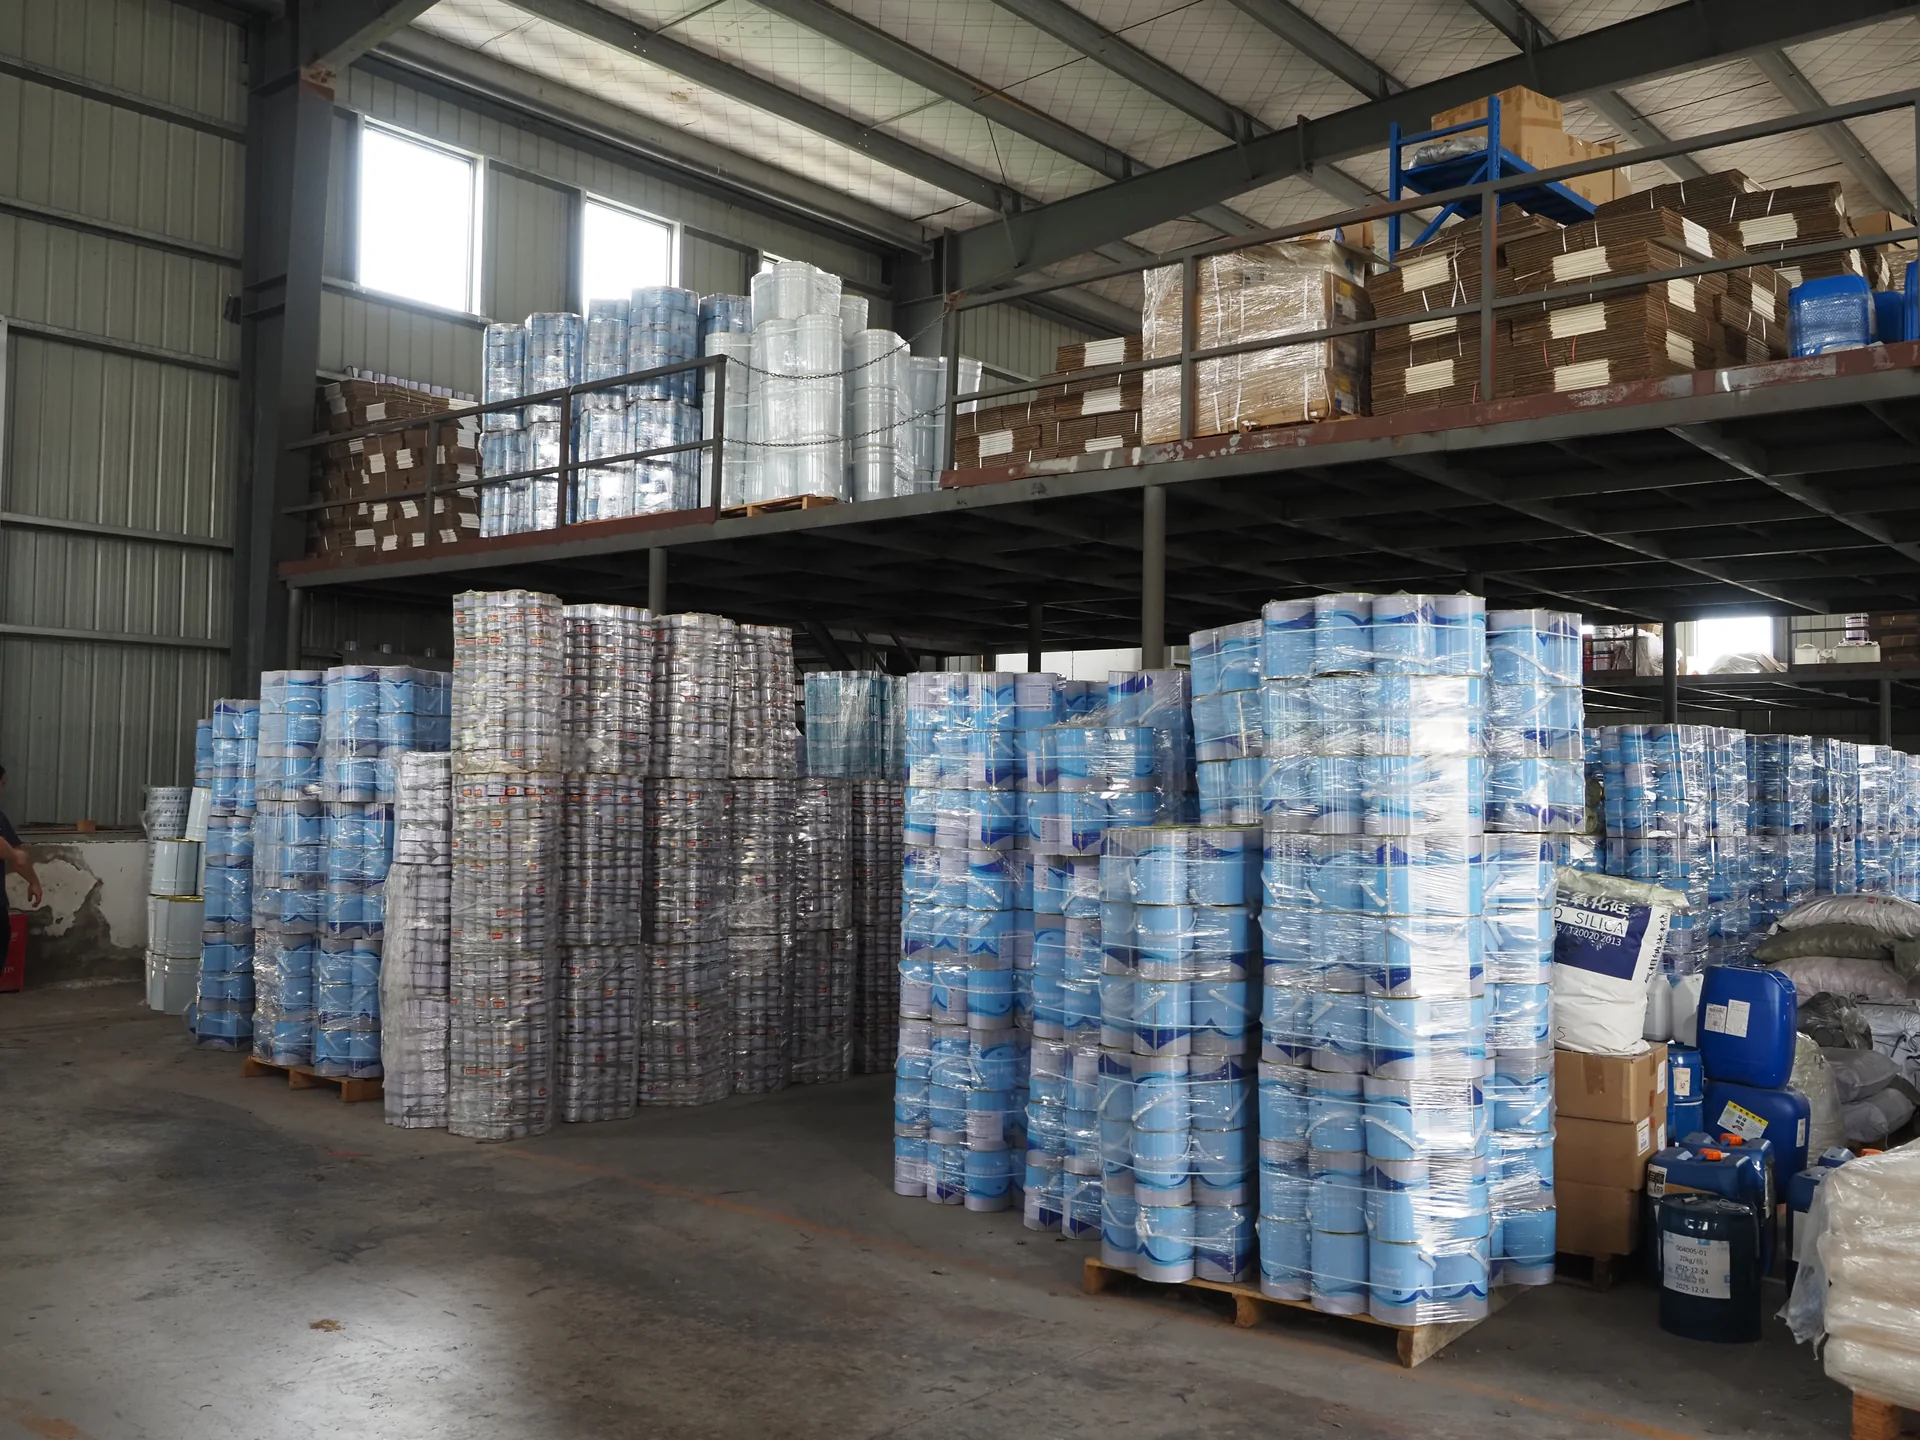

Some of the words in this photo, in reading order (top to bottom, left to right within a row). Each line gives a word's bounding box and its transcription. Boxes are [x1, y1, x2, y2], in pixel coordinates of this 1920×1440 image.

[1574, 912, 1624, 935] SILICA
[1675, 1263, 1709, 1275] 2025-12-24
[1676, 1282, 1709, 1293] 2025-12-24
